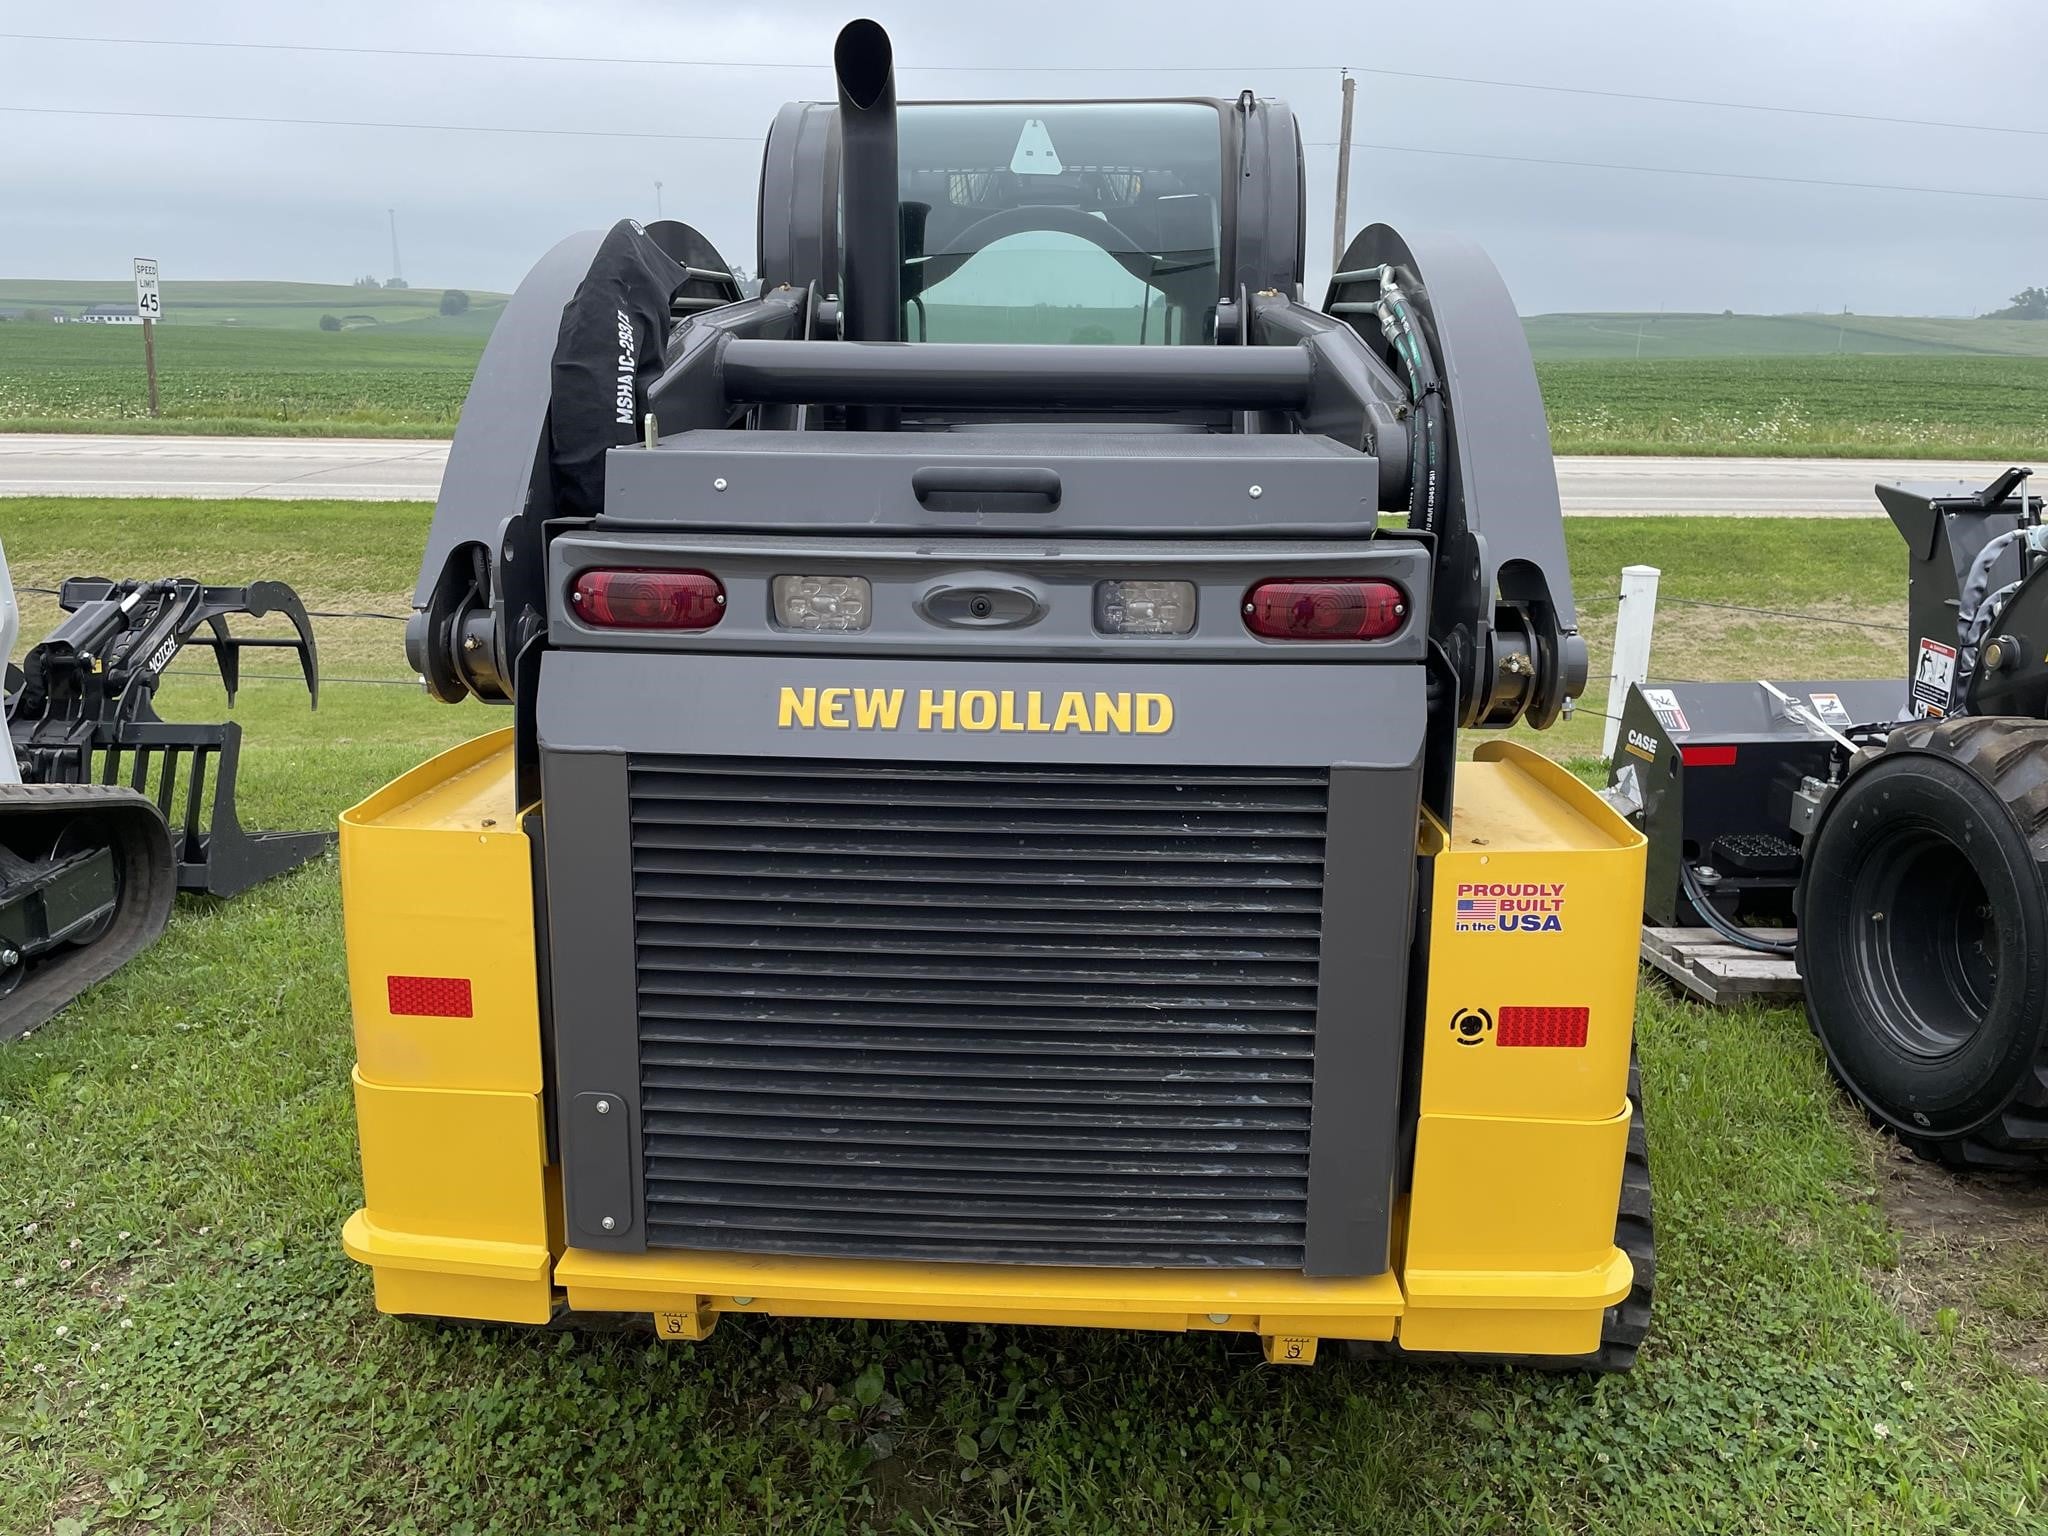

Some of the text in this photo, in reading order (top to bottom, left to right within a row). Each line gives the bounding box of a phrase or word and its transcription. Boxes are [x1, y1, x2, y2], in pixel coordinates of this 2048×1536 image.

[137, 264, 156, 275] SPEED
[140, 293, 159, 312] 45
[616, 374, 634, 425] MSHA
[777, 687, 1175, 735] NEW HOLLAND
[1627, 729, 1658, 754] CASE
[1457, 884, 1565, 897] PROUDLY
[1499, 899, 1565, 912] BUILT
[1456, 914, 1563, 932] in the USA
